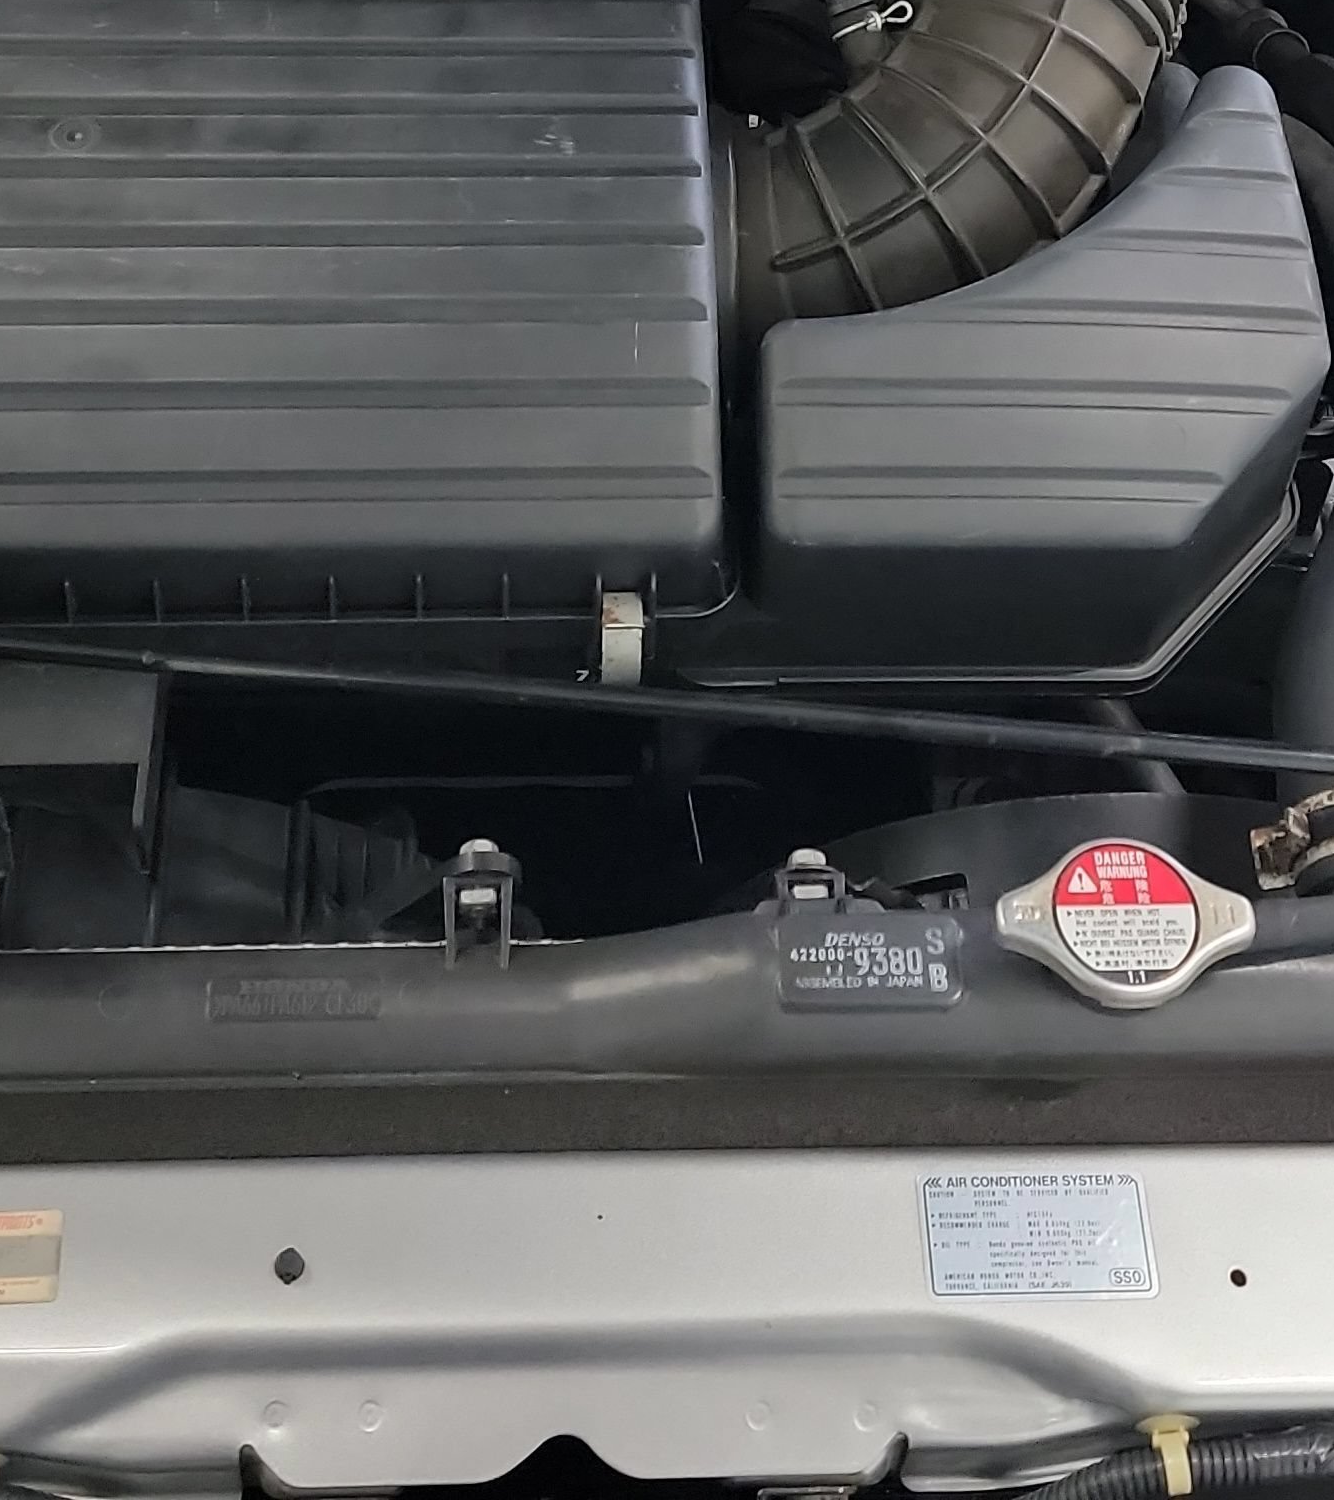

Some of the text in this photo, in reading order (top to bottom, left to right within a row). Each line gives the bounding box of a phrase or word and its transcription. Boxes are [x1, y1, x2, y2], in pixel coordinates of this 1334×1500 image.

[1094, 851, 1146, 865] DANGER
[1096, 865, 1148, 879] WARNUNG
[824, 932, 886, 947] DENSO
[925, 926, 946, 955] S
[886, 976, 924, 988] JAPAN
[928, 963, 949, 992] B
[1128, 970, 1146, 984] 1.1
[946, 1174, 1115, 1188] AIR CONDITIONER SYSTEM
